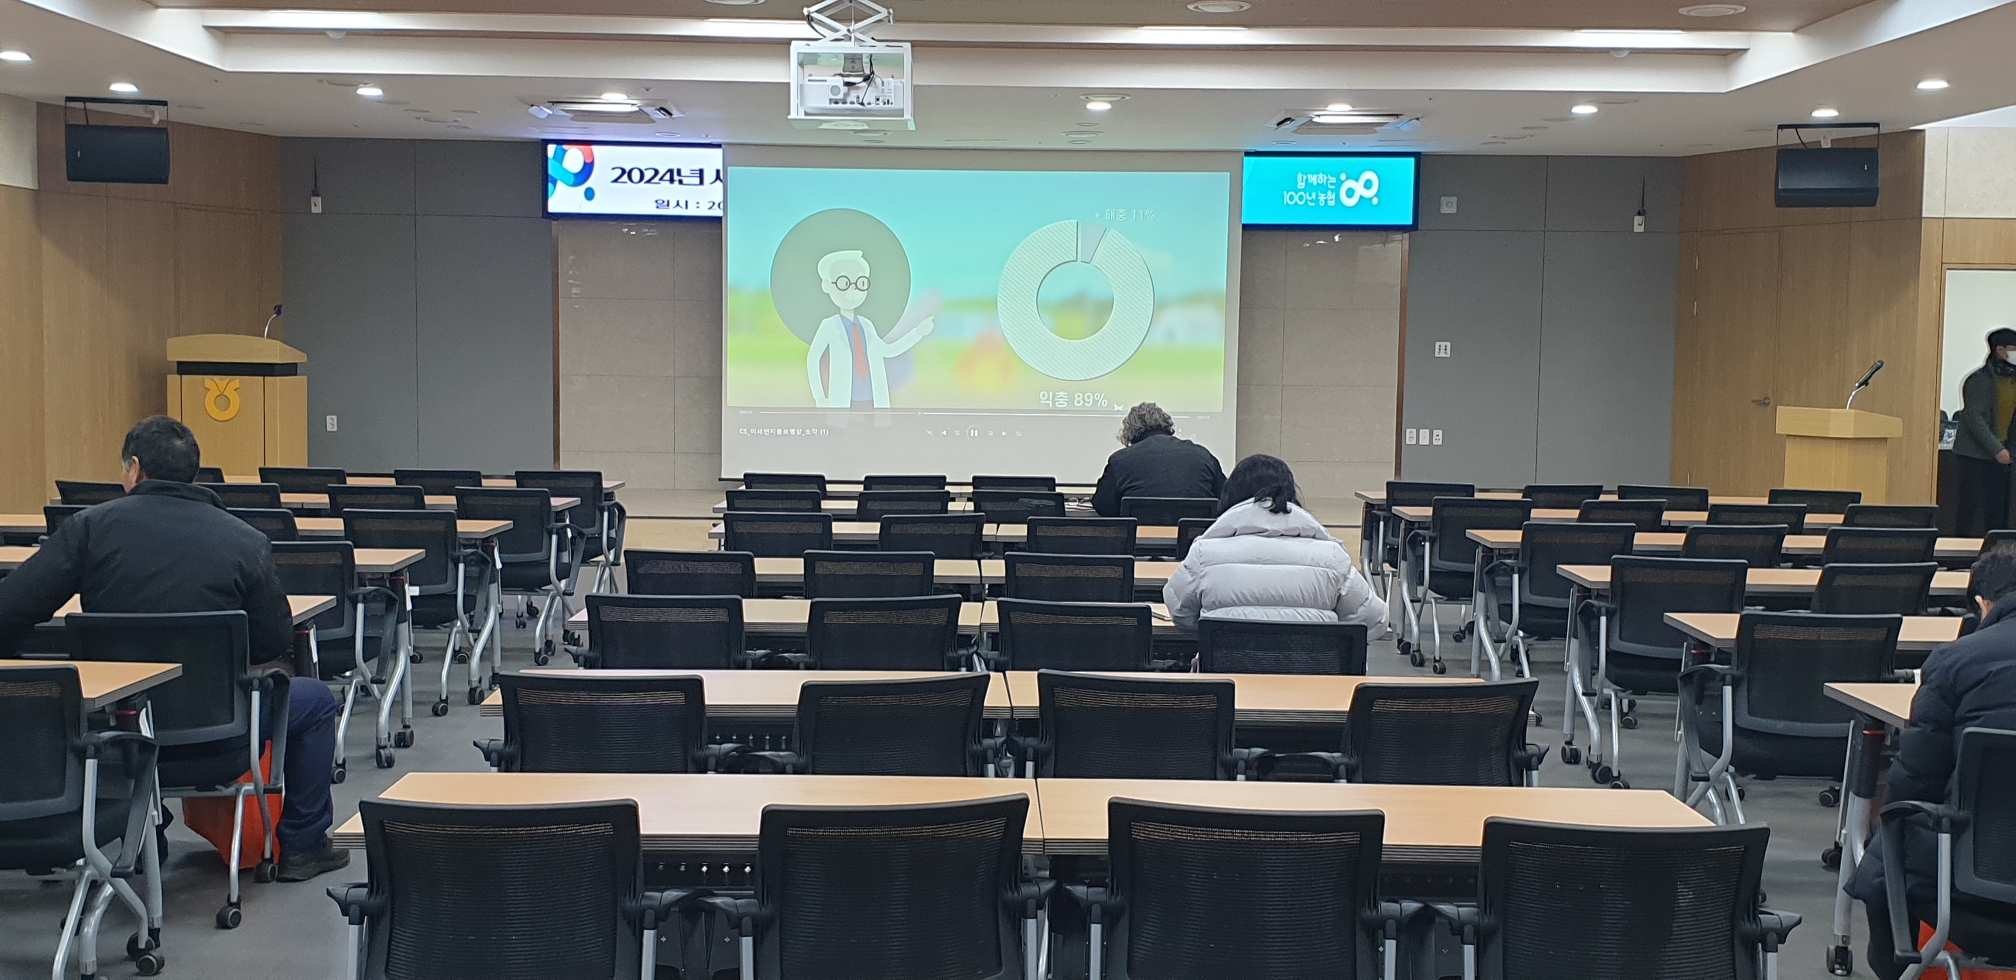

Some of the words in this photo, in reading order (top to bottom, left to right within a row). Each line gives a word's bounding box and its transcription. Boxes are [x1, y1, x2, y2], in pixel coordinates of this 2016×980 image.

[611, 166, 704, 186] 2024년
[1297, 172, 1337, 189] 함께하는
[654, 198, 689, 210] 일시
[1283, 190, 1317, 206] 100년
[1317, 190, 1336, 207] 농협
[1105, 208, 1127, 222] 해충
[1132, 209, 1155, 221] 11%
[1039, 390, 1069, 408] 익충
[1073, 392, 1108, 408] 89%
[820, 428, 829, 436] (1)
